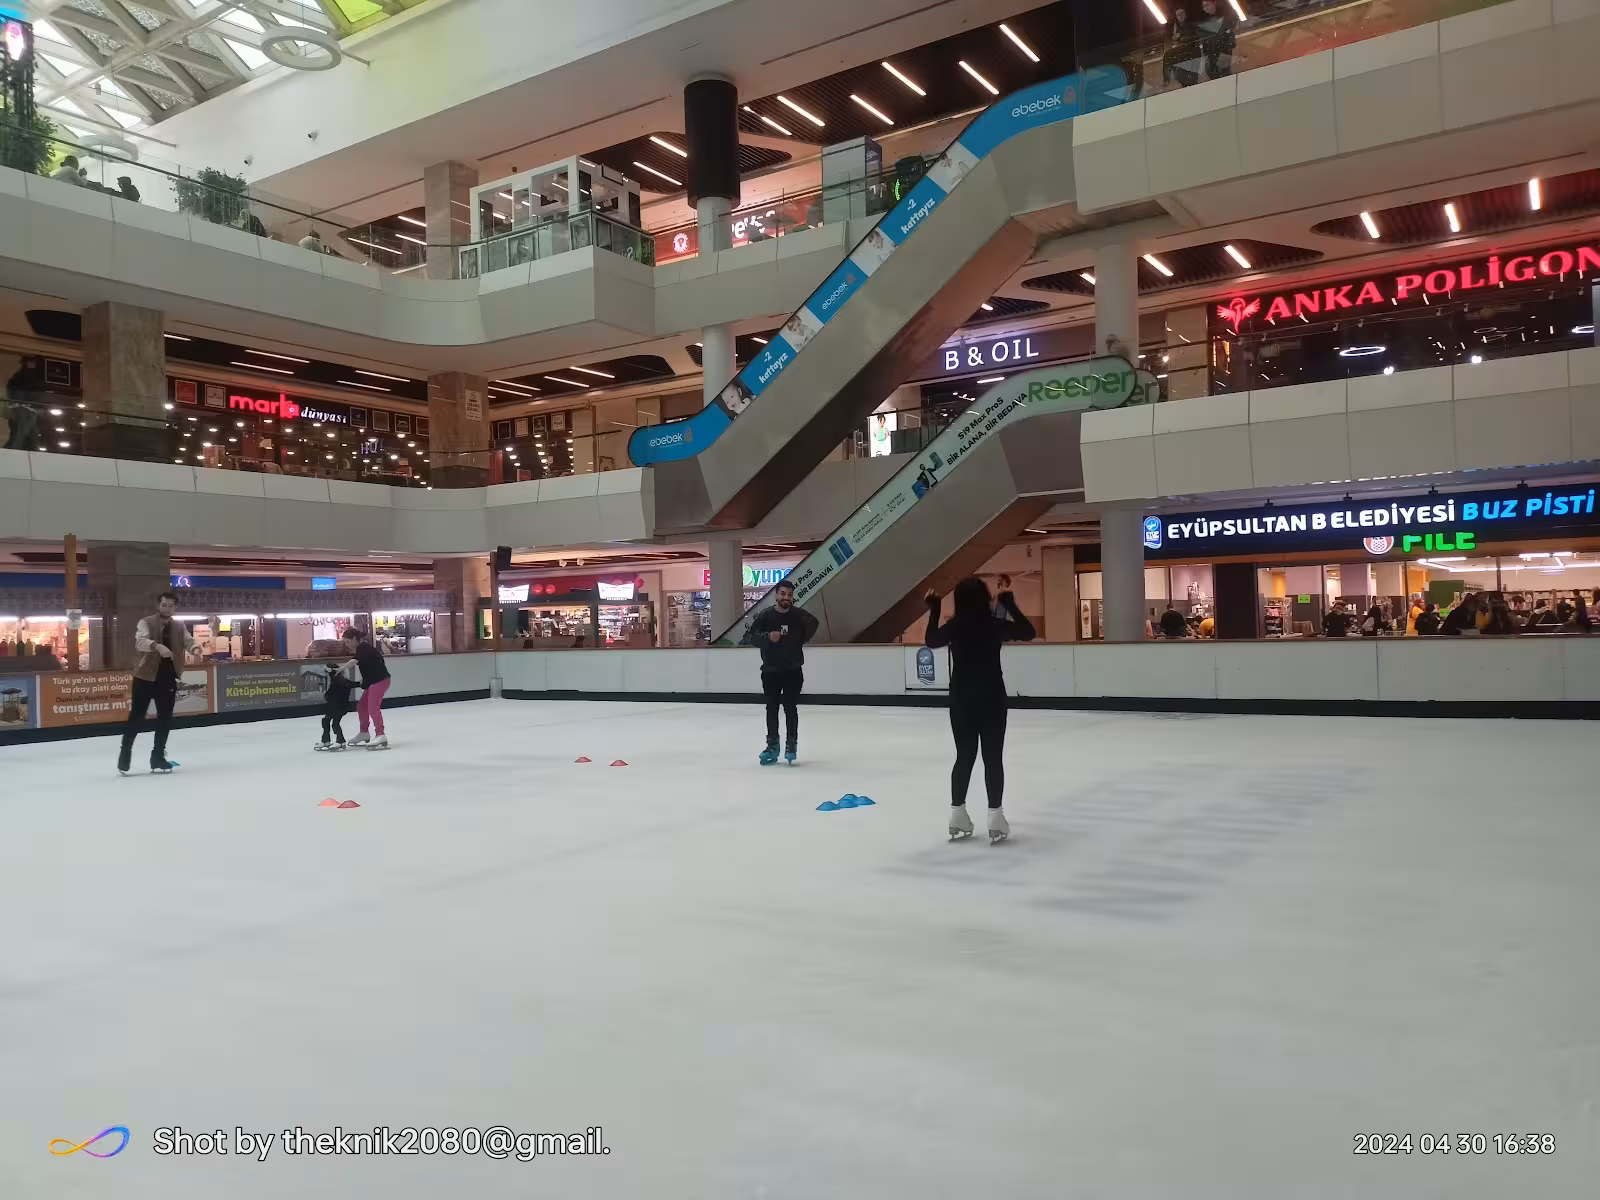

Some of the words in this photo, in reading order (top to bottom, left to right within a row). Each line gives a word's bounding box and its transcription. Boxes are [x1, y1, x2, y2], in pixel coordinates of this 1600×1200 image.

[1011, 94, 1061, 117] ebebek
[1264, 281, 1384, 320] ANKA
[1395, 246, 1600, 300] POLİGON
[822, 281, 848, 310] ebebek
[945, 350, 959, 371] B
[967, 346, 984, 367] &
[991, 337, 1039, 362] OIL
[301, 407, 347, 424] dünyası
[969, 413, 987, 430] Max
[985, 396, 1004, 416] ProS
[649, 432, 683, 447] ebebek
[946, 452, 960, 466] BİR
[959, 430, 987, 458] ALANA,
[984, 418, 999, 432] BİR
[1167, 514, 1307, 539] EYÜPSULTAN
[1525, 489, 1595, 517] PİSTİ
[92, 684, 109, 693] pisti
[110, 683, 128, 691] olan
[110, 674, 134, 684] büyük
[226, 683, 297, 698] Kütüphanemiz
[52, 701, 110, 714] tanıştınız
